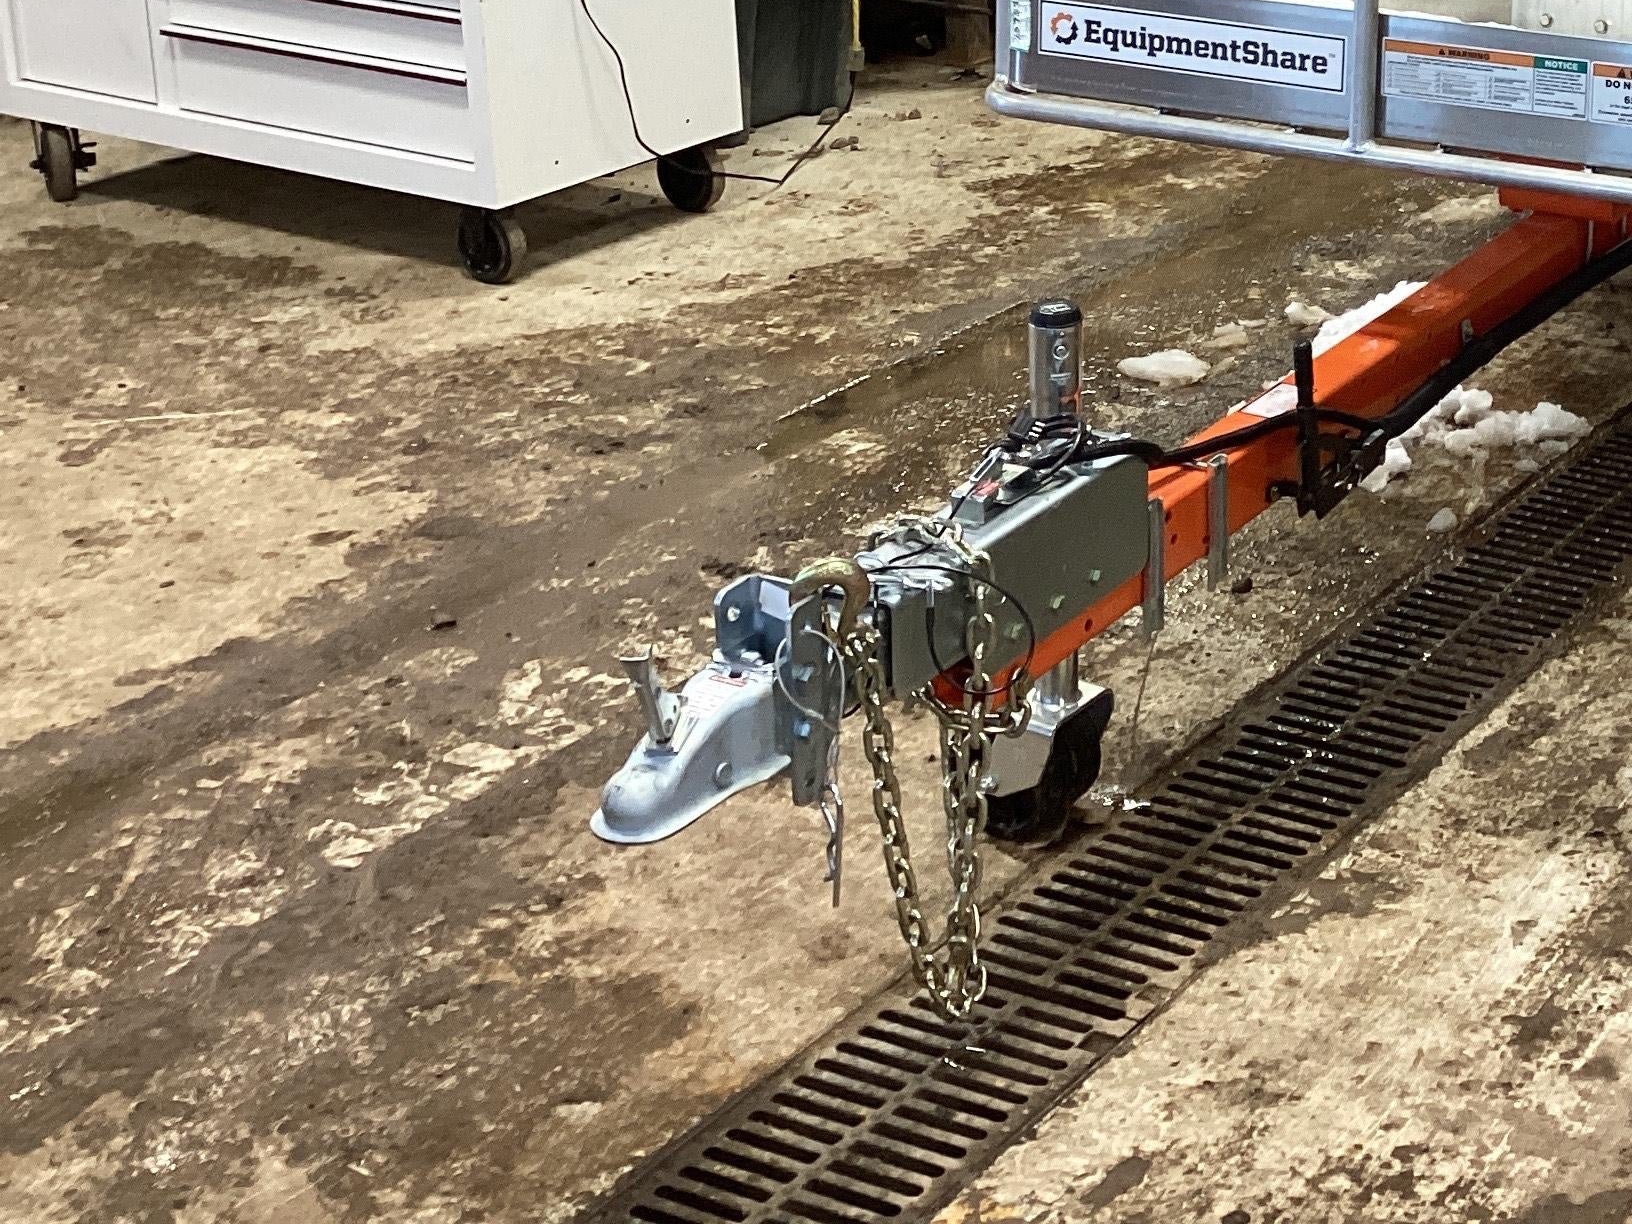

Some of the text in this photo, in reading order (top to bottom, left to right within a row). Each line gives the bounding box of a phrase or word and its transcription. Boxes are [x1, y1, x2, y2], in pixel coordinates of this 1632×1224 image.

[1084, 19, 1328, 74] EquipmentShare
[1448, 49, 1490, 61] WARNING
[1544, 60, 1579, 71] NOTICE
[1605, 79, 1621, 89] DO
